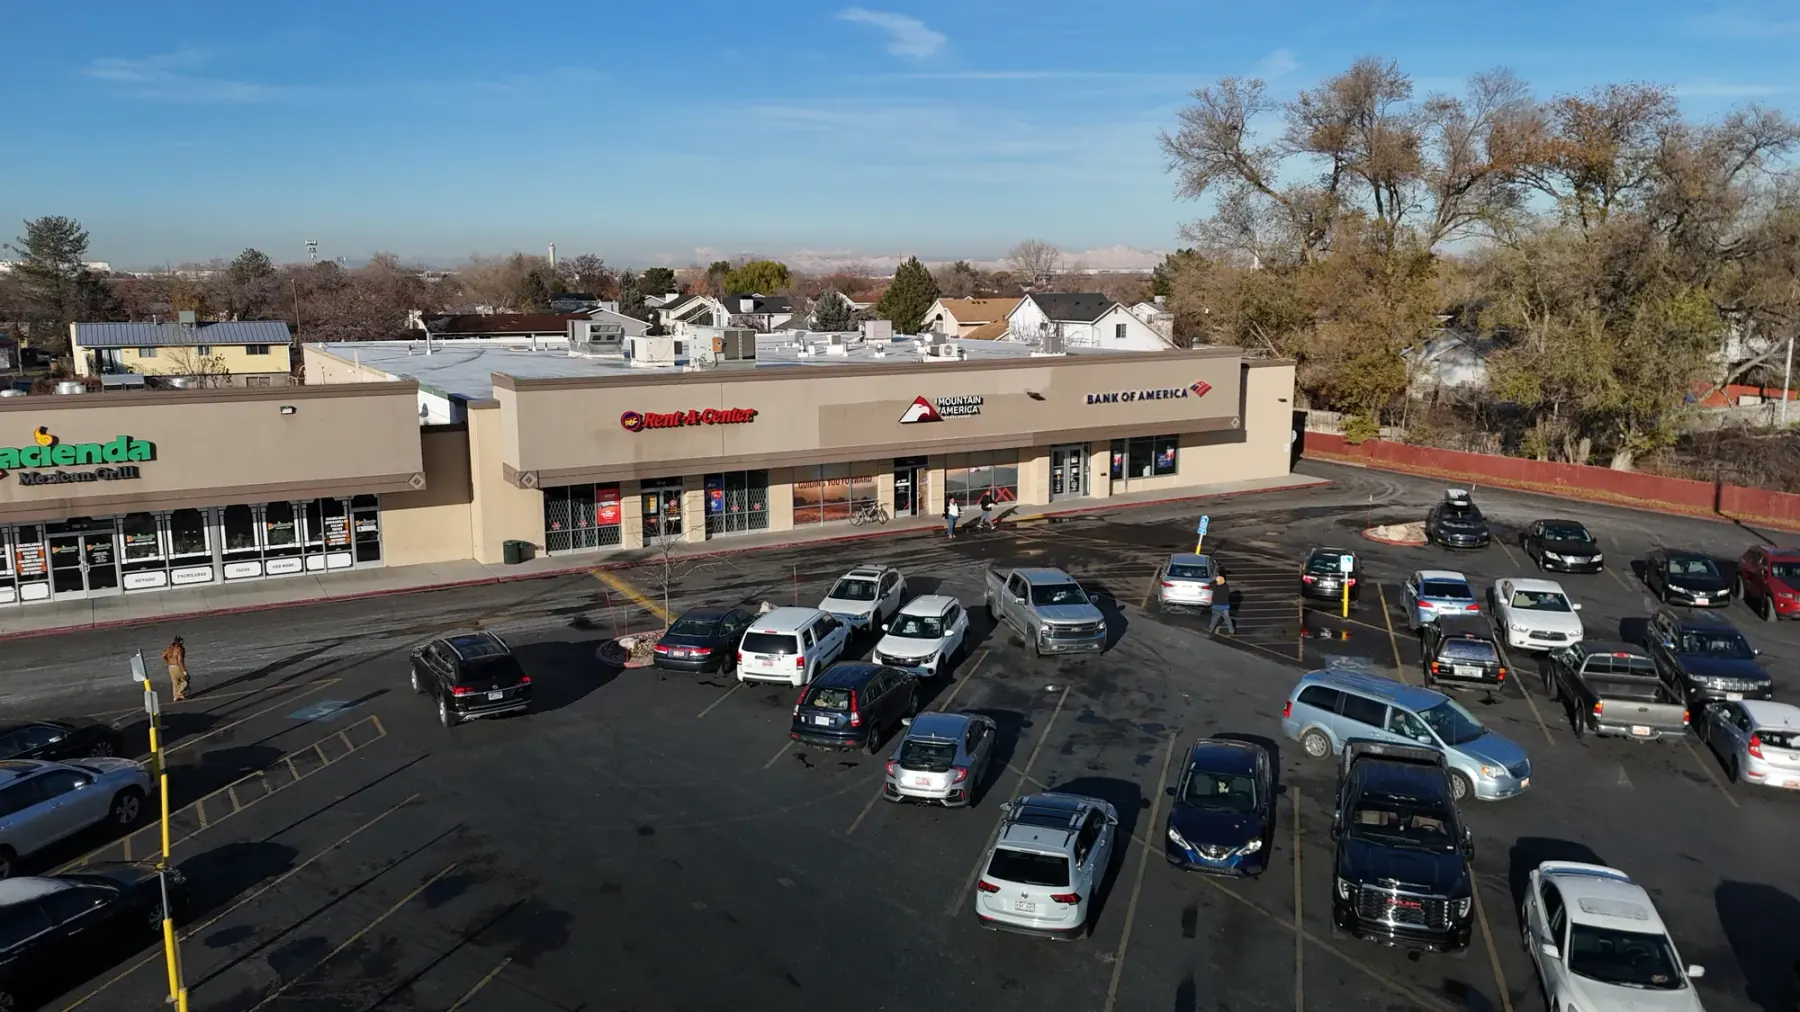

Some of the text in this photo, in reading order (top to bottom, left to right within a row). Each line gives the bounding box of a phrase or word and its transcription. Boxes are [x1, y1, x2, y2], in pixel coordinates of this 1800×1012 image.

[938, 396, 981, 406] MOUNTAIN
[1087, 387, 1188, 405] BANK OF AMERICA
[940, 405, 979, 415] AMERICA
[643, 407, 756, 429] Rent-A-Center
[95, 465, 141, 482] Grill
[827, 478, 841, 487] YOU
